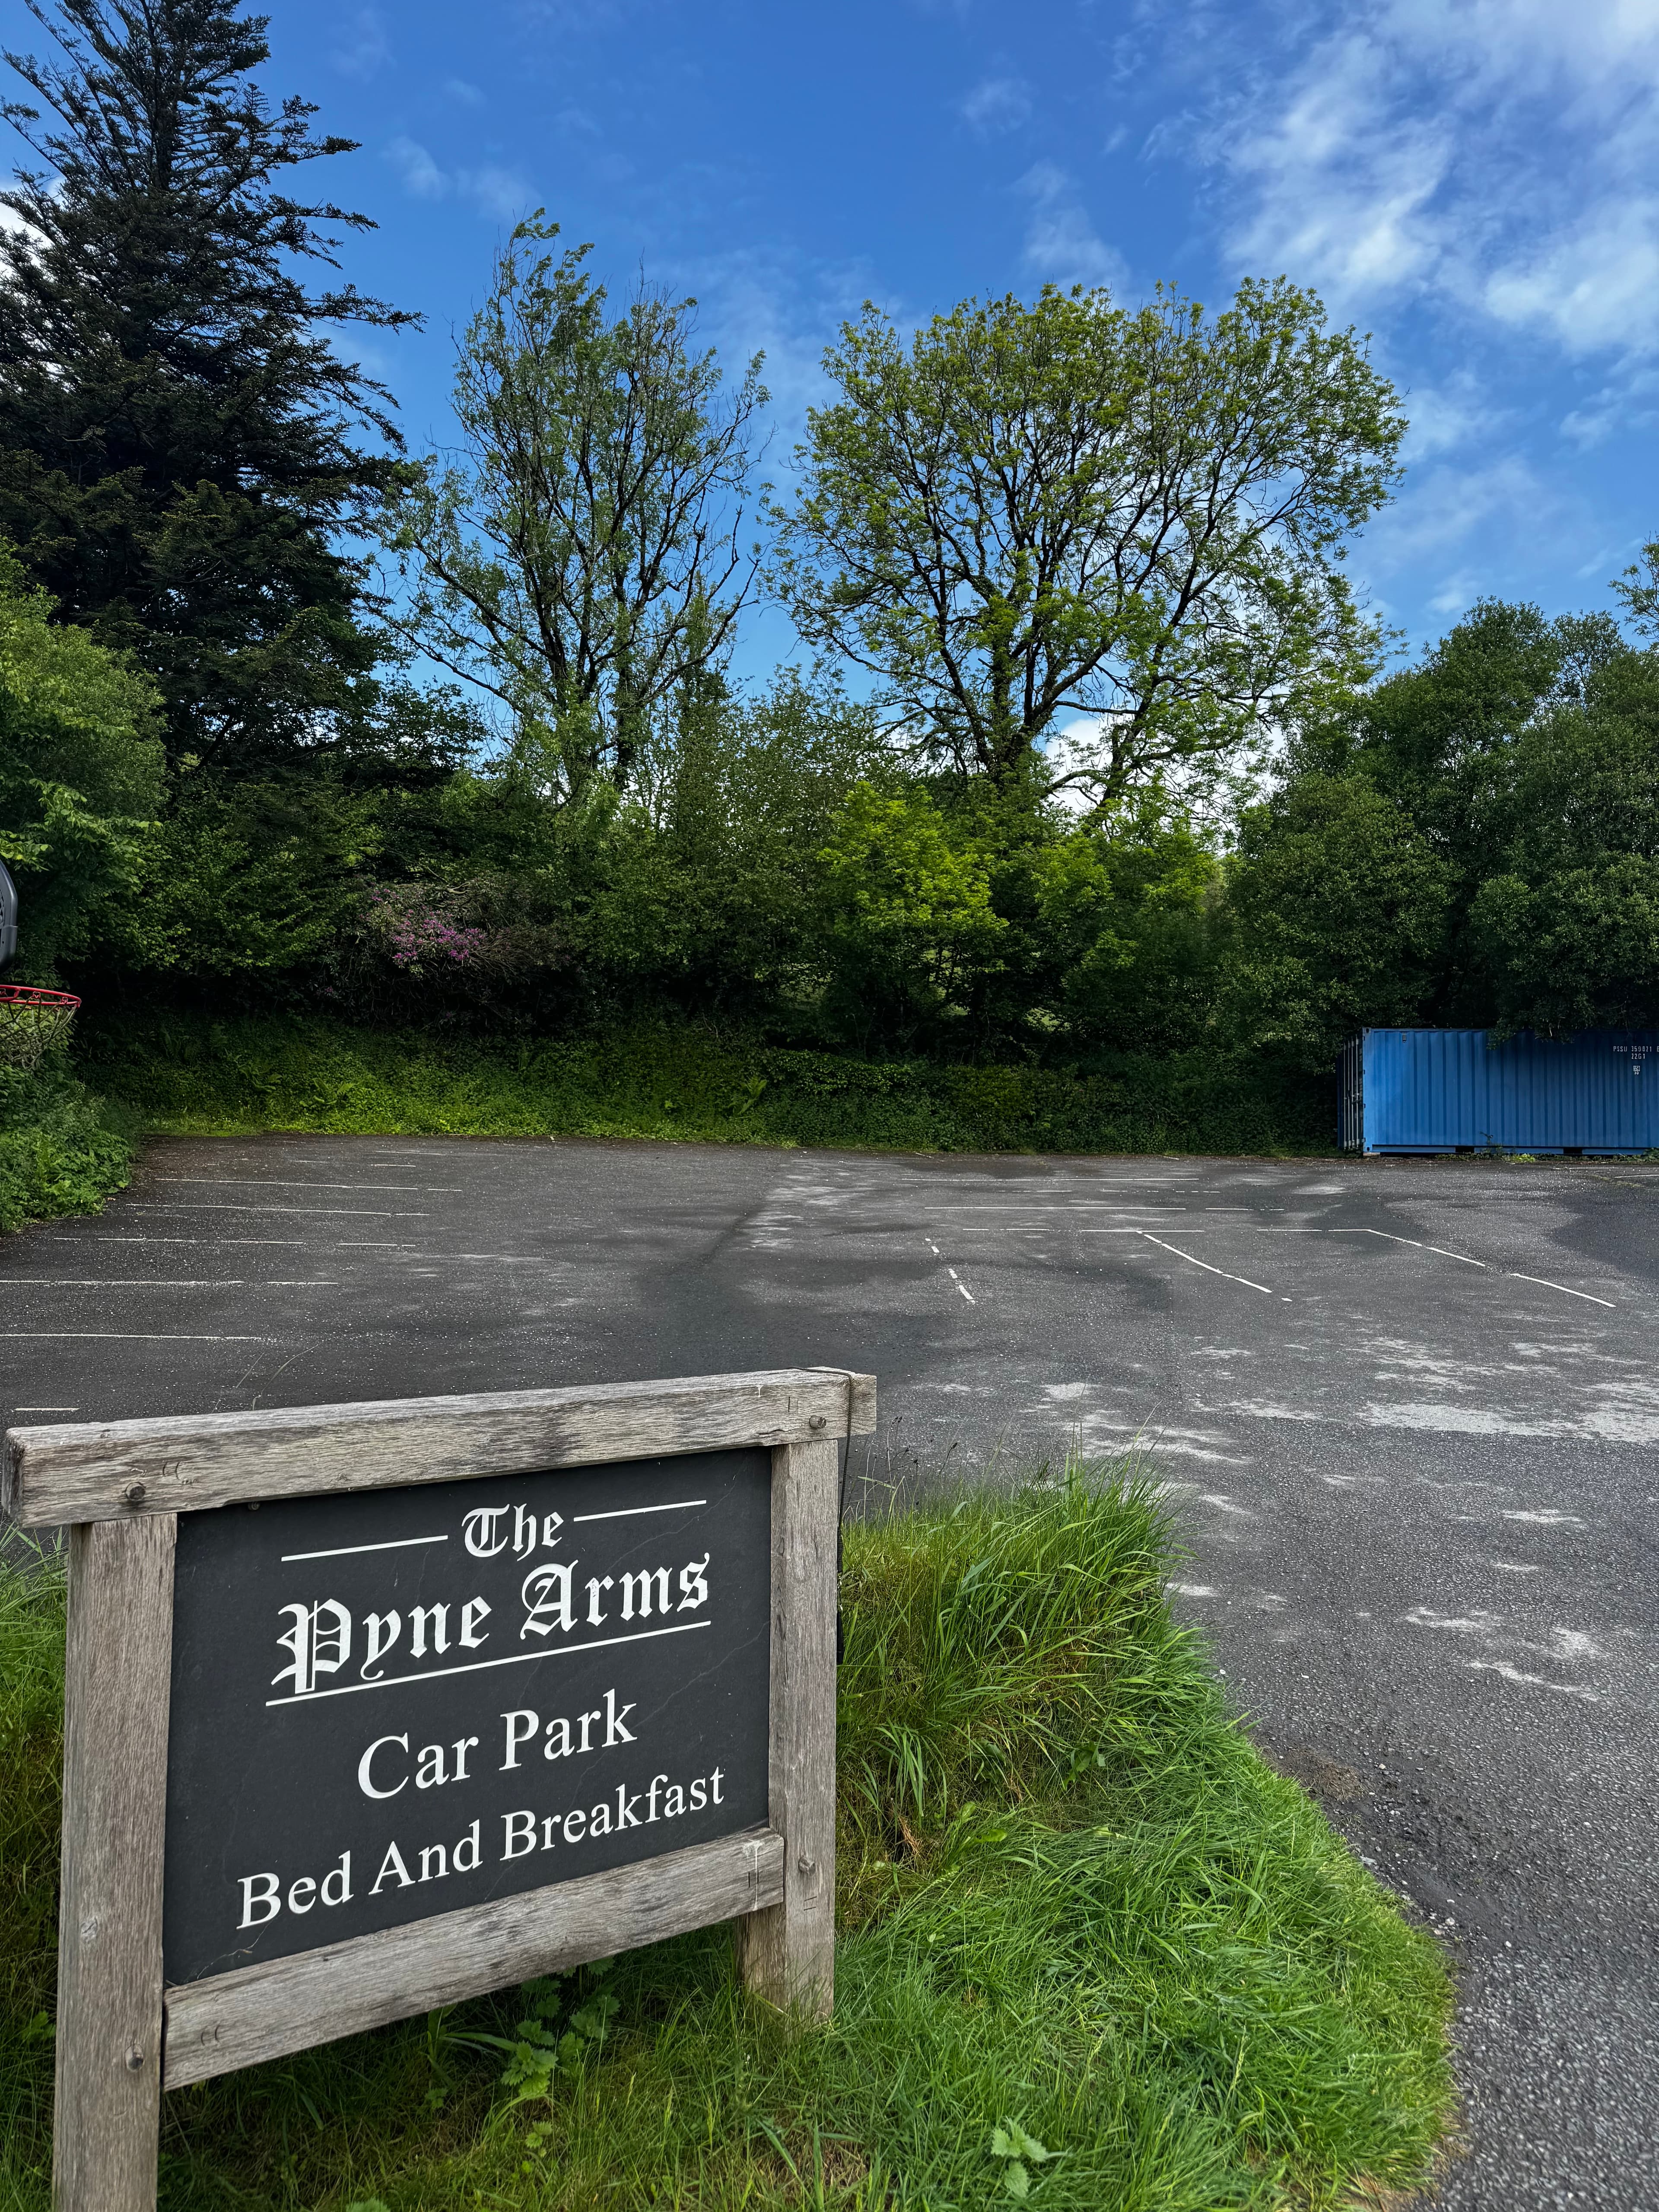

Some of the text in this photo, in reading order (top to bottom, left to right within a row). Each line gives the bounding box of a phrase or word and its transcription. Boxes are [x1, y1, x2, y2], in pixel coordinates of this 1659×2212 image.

[461, 1503, 564, 1561] The
[270, 1552, 710, 1694] Pyne Arms
[358, 1688, 638, 1799] Car Park
[236, 1766, 725, 1929] Bed And Breakfast
